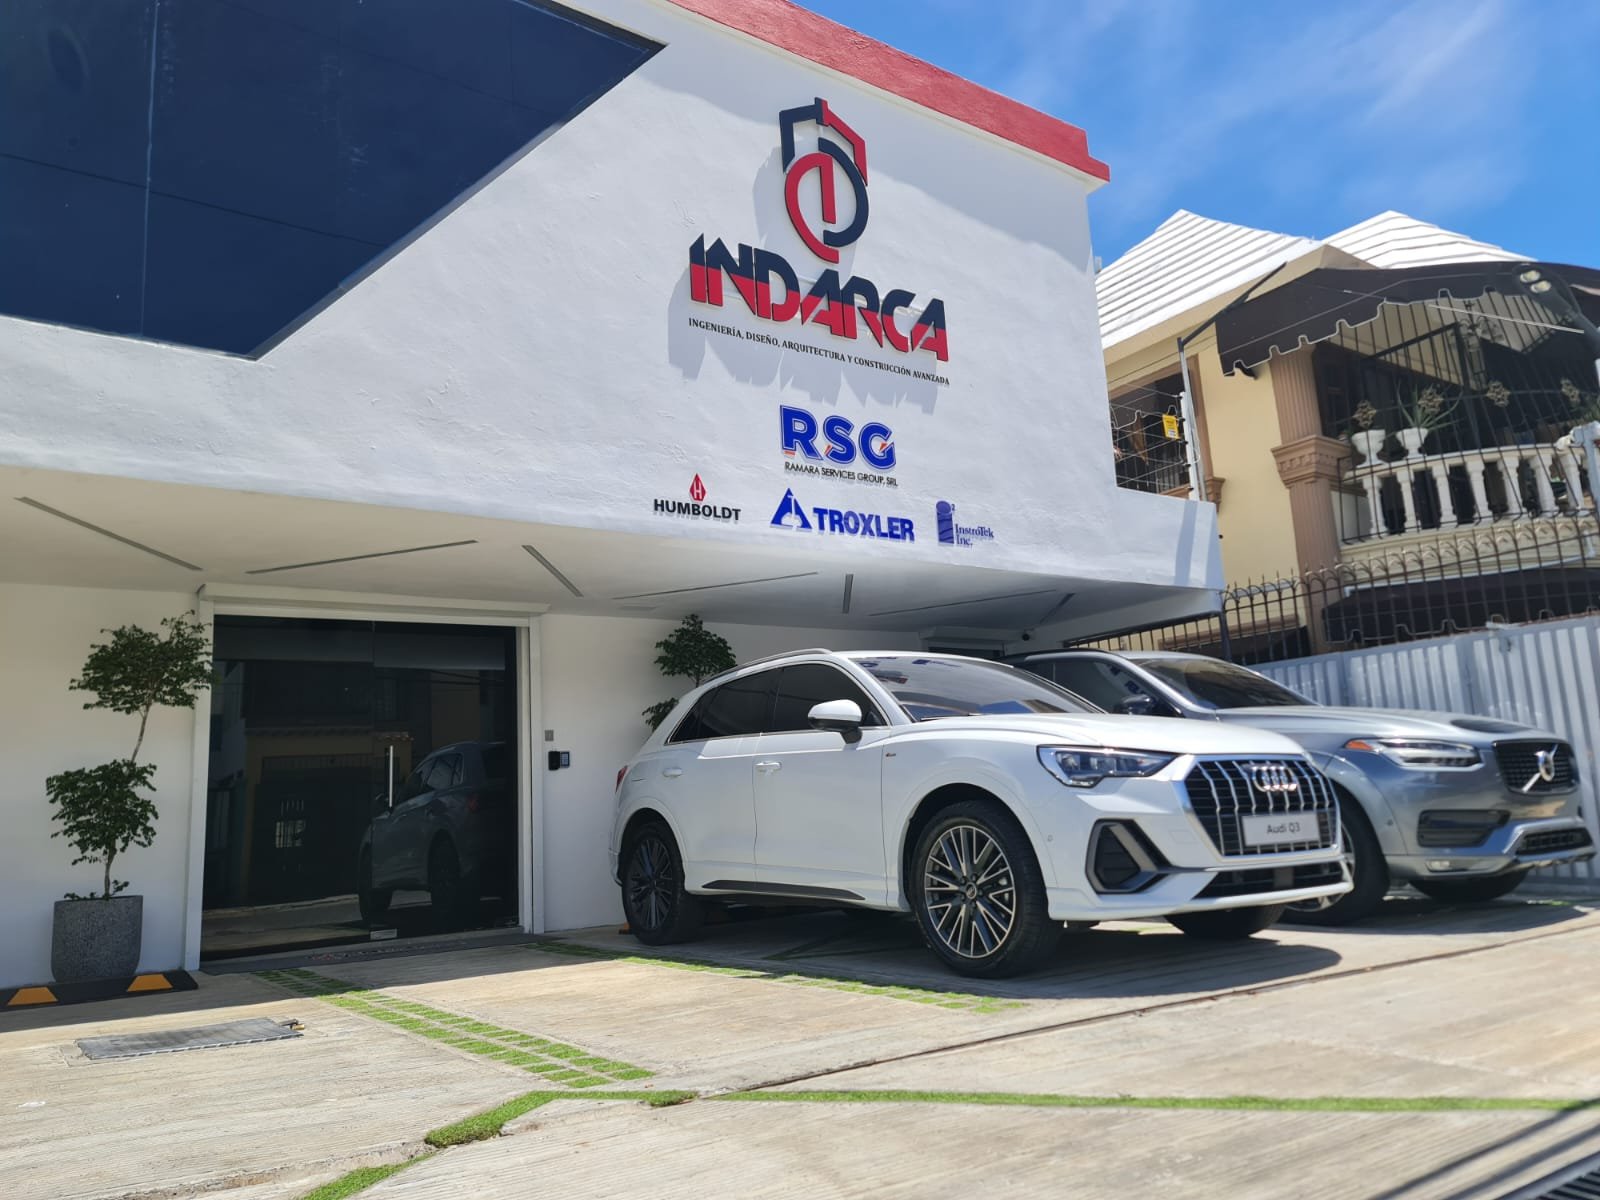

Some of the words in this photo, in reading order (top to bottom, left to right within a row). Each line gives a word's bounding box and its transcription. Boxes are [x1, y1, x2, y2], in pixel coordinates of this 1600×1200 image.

[689, 233, 949, 362] INDARCA
[688, 317, 744, 340] INGENIERÍA,
[746, 331, 780, 348] DISEÑO,
[782, 340, 845, 362] ARQUITECTURA
[847, 355, 853, 363] Y
[854, 356, 911, 376] CONSTRUCCIÓN
[913, 371, 950, 385] AVANZADA
[780, 404, 896, 471] RSG
[784, 461, 820, 475] RAMARA
[821, 467, 856, 480] SERVICES
[857, 472, 885, 485] GROUP,
[653, 498, 742, 521] HUMBOLDT
[812, 507, 916, 541] TROXLER
[955, 523, 994, 539] InstroTek
[1266, 824, 1287, 834] Audi
[1288, 822, 1301, 833] Q3
